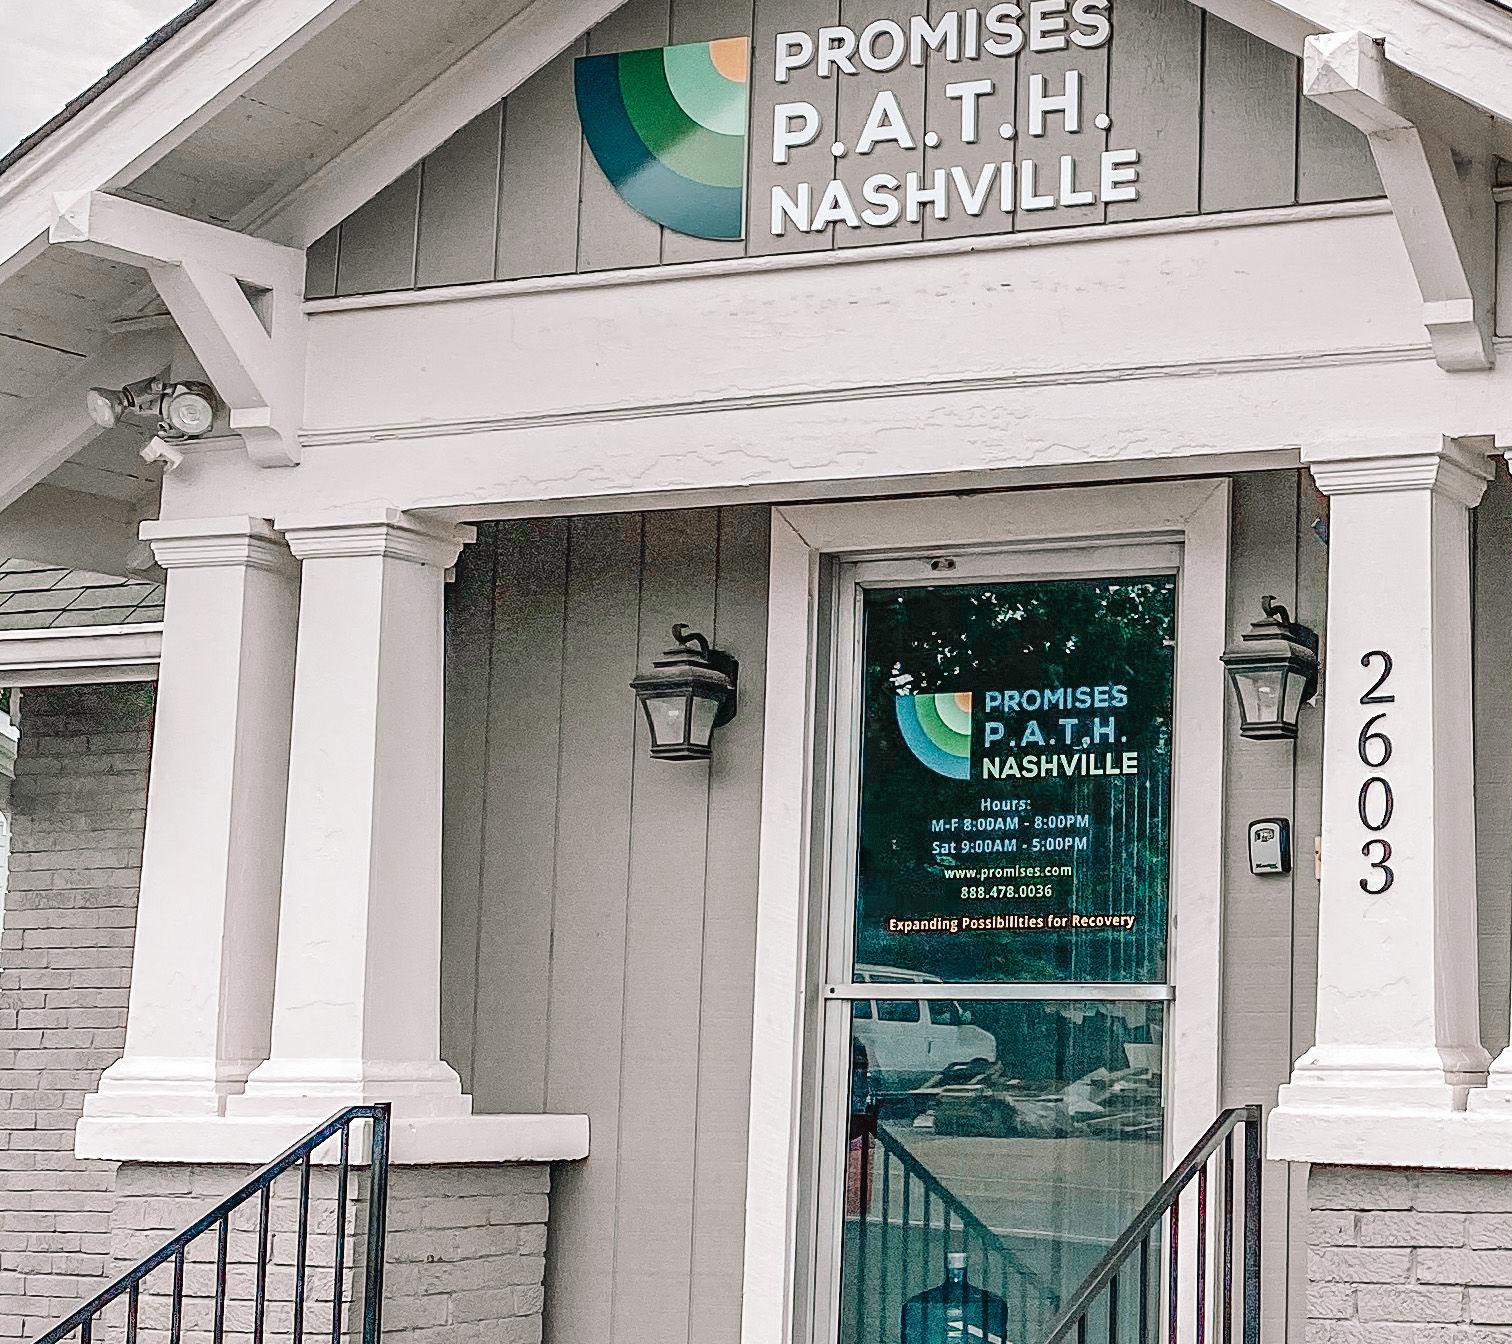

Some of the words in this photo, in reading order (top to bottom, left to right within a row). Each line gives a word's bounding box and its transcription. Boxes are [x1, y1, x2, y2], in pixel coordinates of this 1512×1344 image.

[772, 68, 1111, 165] P.A.T.H.
[770, 148, 1139, 236] NASHVILLE
[985, 684, 1128, 713] PROMISES
[984, 716, 1127, 748] P.A.T.H.
[982, 751, 1138, 779] NASHVILLE
[1358, 650, 1395, 895] 2603
[980, 798, 1032, 812] Hours:
[931, 818, 959, 832] M-F
[963, 816, 1019, 831] 8:00AM
[1034, 814, 1089, 829] 8:00PM
[931, 840, 956, 854] Sat
[961, 838, 1017, 853] 9:00AM
[1032, 836, 1088, 852] 5:00PM
[944, 865, 1072, 881] www.promises.com
[960, 884, 1052, 899] 888.478.0036
[889, 916, 958, 933] Expanding
[962, 914, 1044, 931] Possibilities
[1047, 913, 1068, 928] for
[1072, 913, 1135, 929] Recovery
